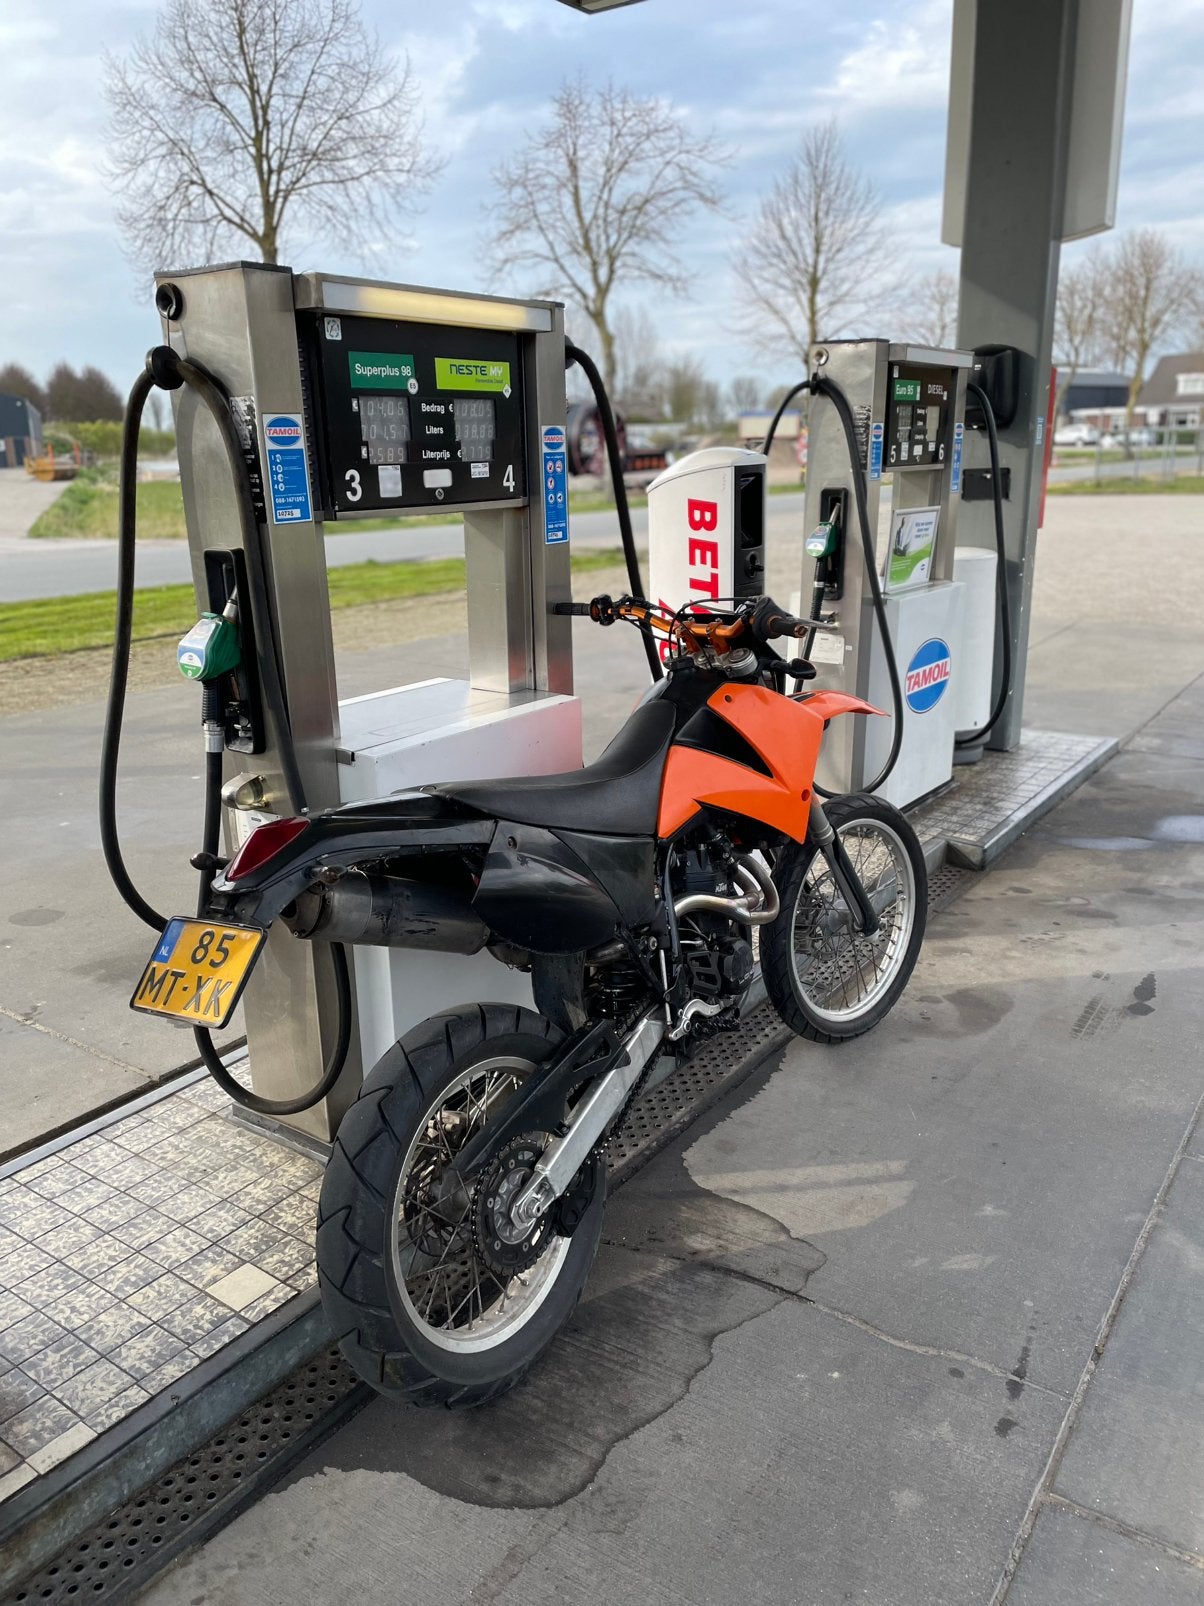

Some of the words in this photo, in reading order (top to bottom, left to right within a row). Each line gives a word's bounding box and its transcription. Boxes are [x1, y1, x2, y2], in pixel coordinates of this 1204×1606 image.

[355, 363, 399, 377] Superplus
[400, 365, 412, 377] 98
[450, 363, 487, 376] NESTE
[489, 366, 503, 377] MY
[896, 385, 907, 394] Euro
[928, 384, 944, 395] DIESEL
[421, 403, 445, 414] Bedrag
[267, 428, 301, 436] TAMOIL
[425, 425, 444, 434] Liters
[422, 449, 450, 460] Literprijs
[890, 445, 896, 463] 5
[938, 443, 945, 460] 6
[345, 469, 363, 501] 3
[502, 464, 516, 492] 4
[907, 660, 950, 692] TAMOIL
[159, 945, 169, 956] NL
[190, 929, 237, 969] 85
